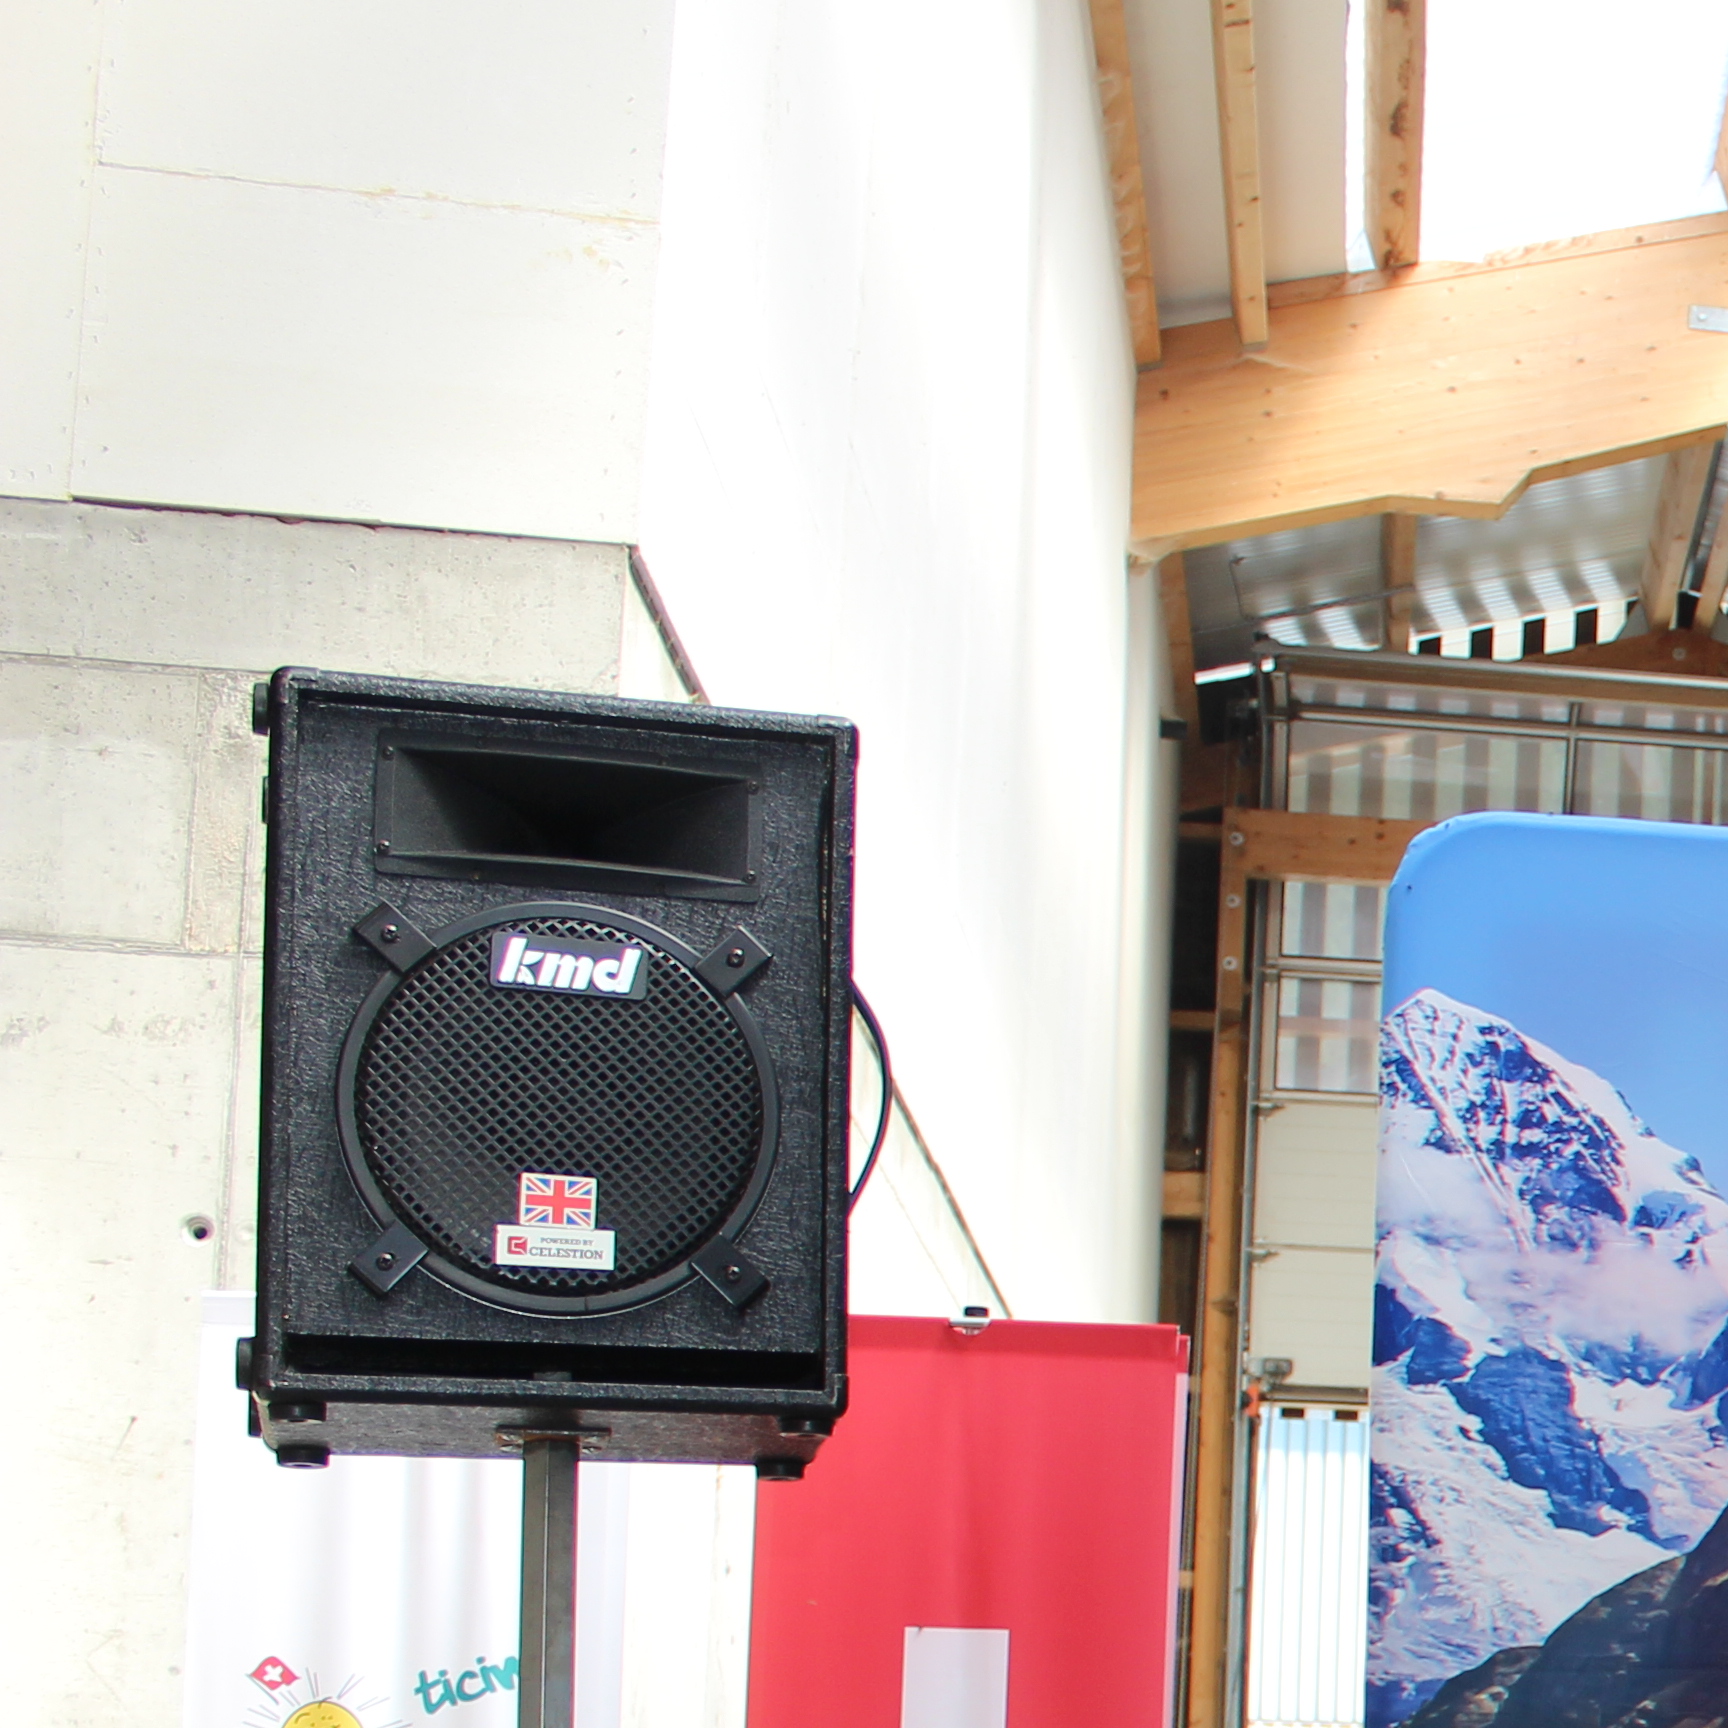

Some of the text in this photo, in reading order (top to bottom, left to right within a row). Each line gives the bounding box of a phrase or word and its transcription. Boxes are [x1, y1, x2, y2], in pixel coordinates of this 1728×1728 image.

[497, 936, 643, 994] kmd
[529, 1246, 604, 1260] CELESTION
[540, 1237, 595, 1247] POWERED BY
[414, 1656, 520, 1715] ticin
